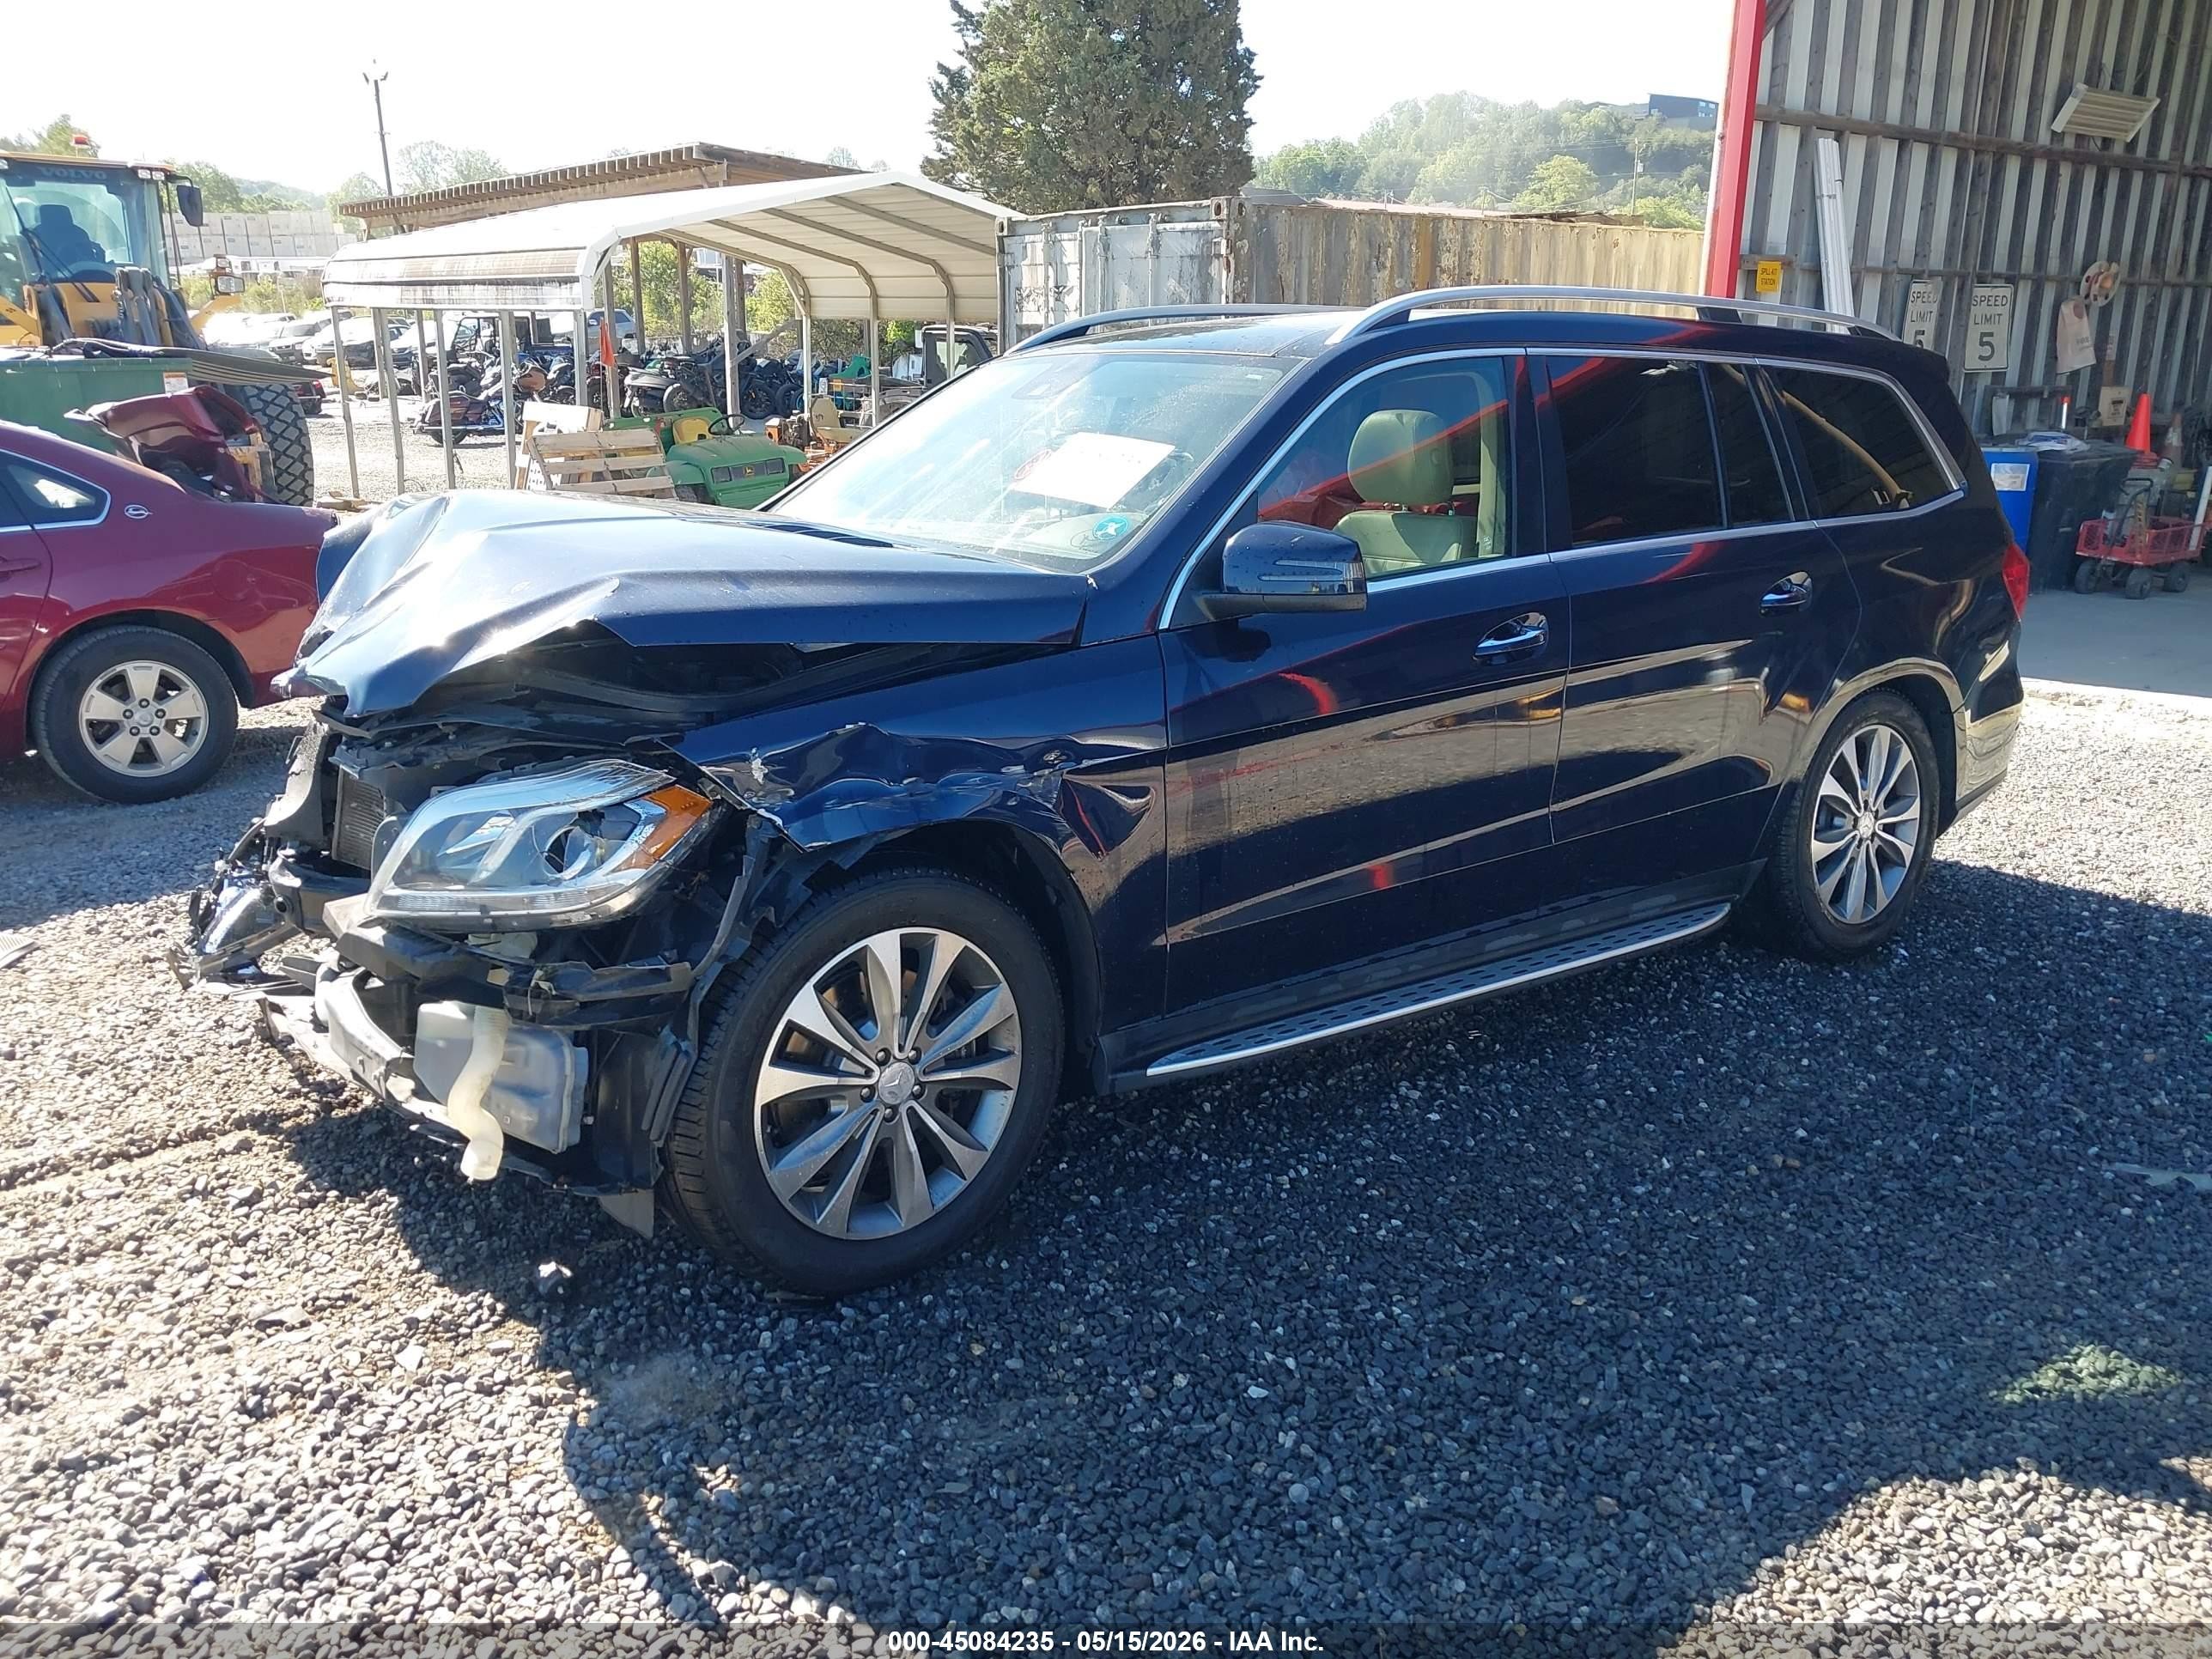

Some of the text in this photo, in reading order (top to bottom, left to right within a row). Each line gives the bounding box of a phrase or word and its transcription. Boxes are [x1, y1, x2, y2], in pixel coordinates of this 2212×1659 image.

[39, 166, 107, 180] VOLVO
[1972, 295, 2008, 307] SPEED
[1910, 310, 1933, 323] LIMIT
[1974, 313, 2003, 325] LIMIT
[1978, 331, 1996, 362] 5
